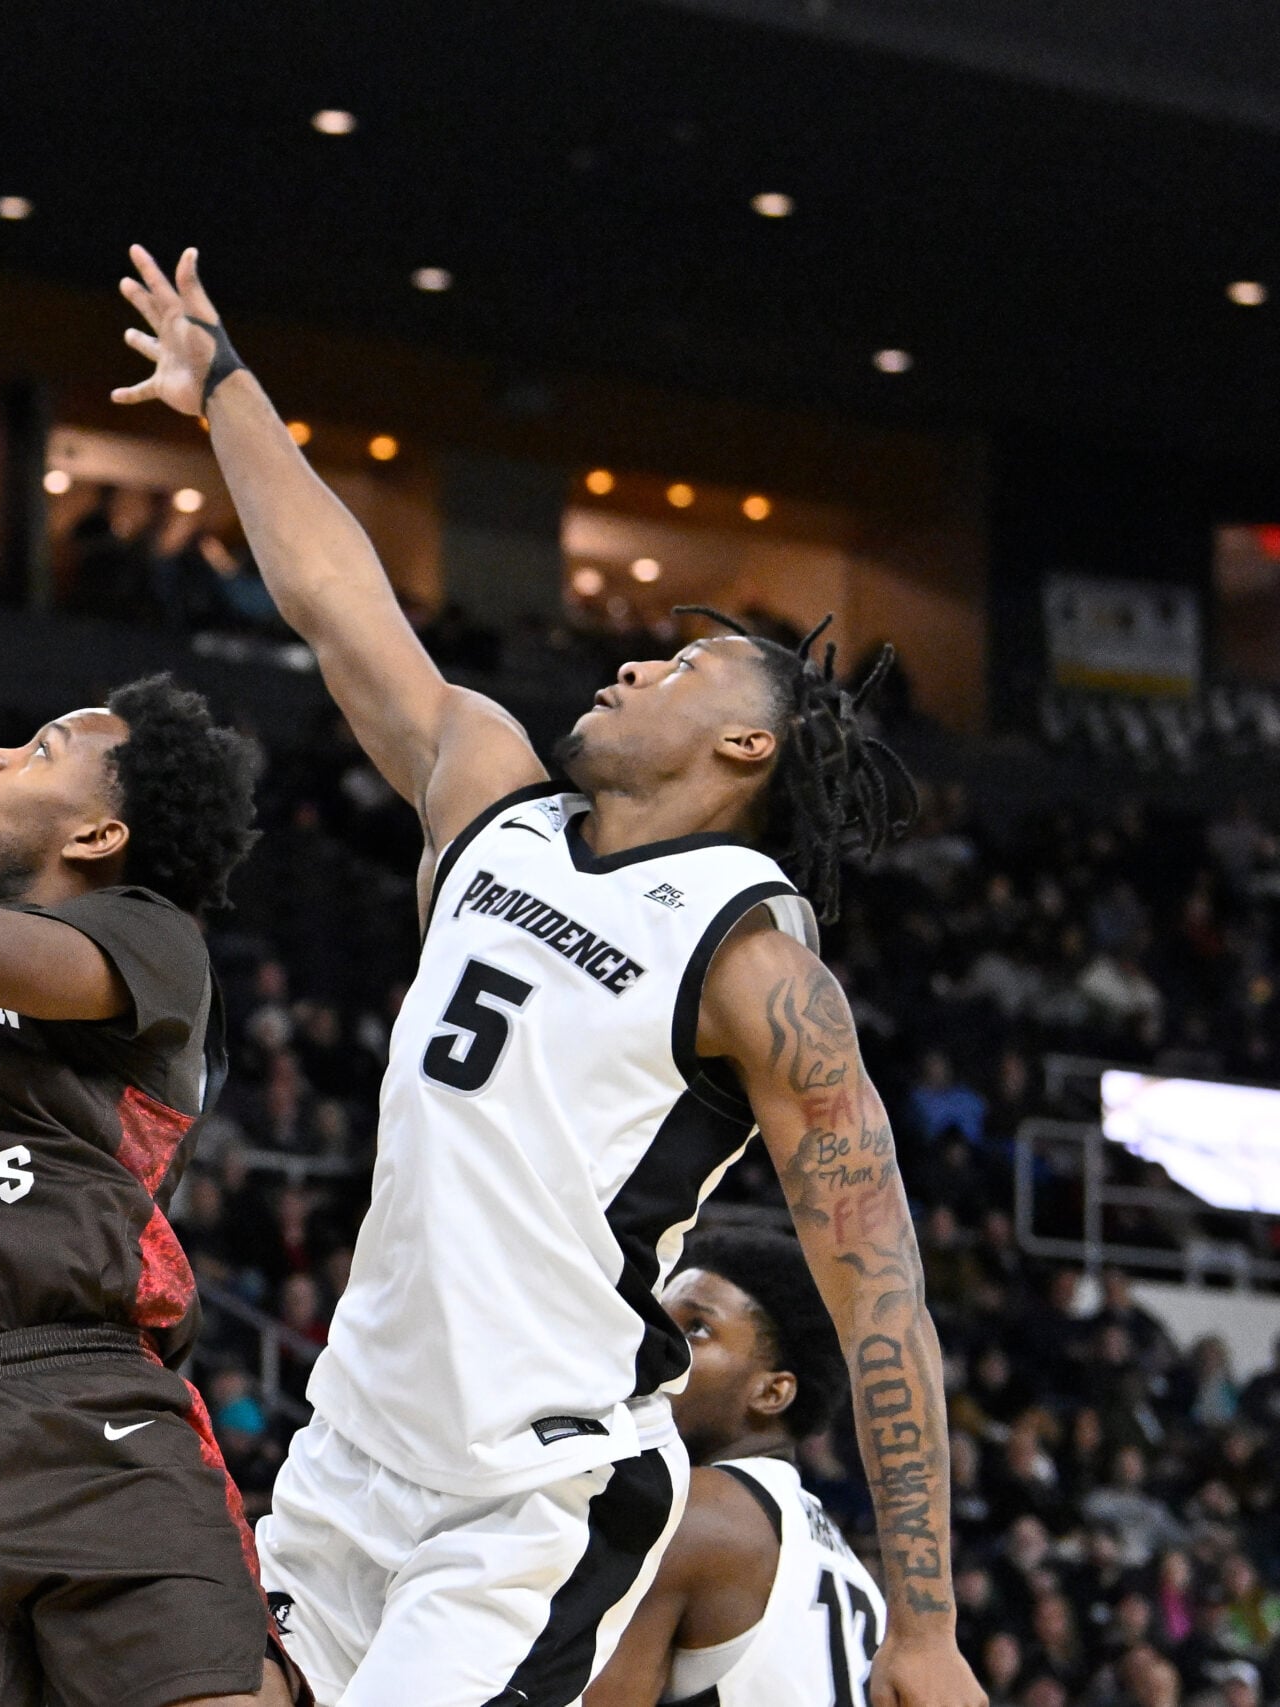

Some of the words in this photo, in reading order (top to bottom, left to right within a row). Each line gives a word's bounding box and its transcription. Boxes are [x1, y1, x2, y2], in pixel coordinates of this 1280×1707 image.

[648, 889, 685, 909] EAST
[658, 882, 685, 899] BIG
[452, 869, 649, 999] PROVIDENCE
[419, 953, 542, 1098] 5
[817, 1132, 851, 1166] Be
